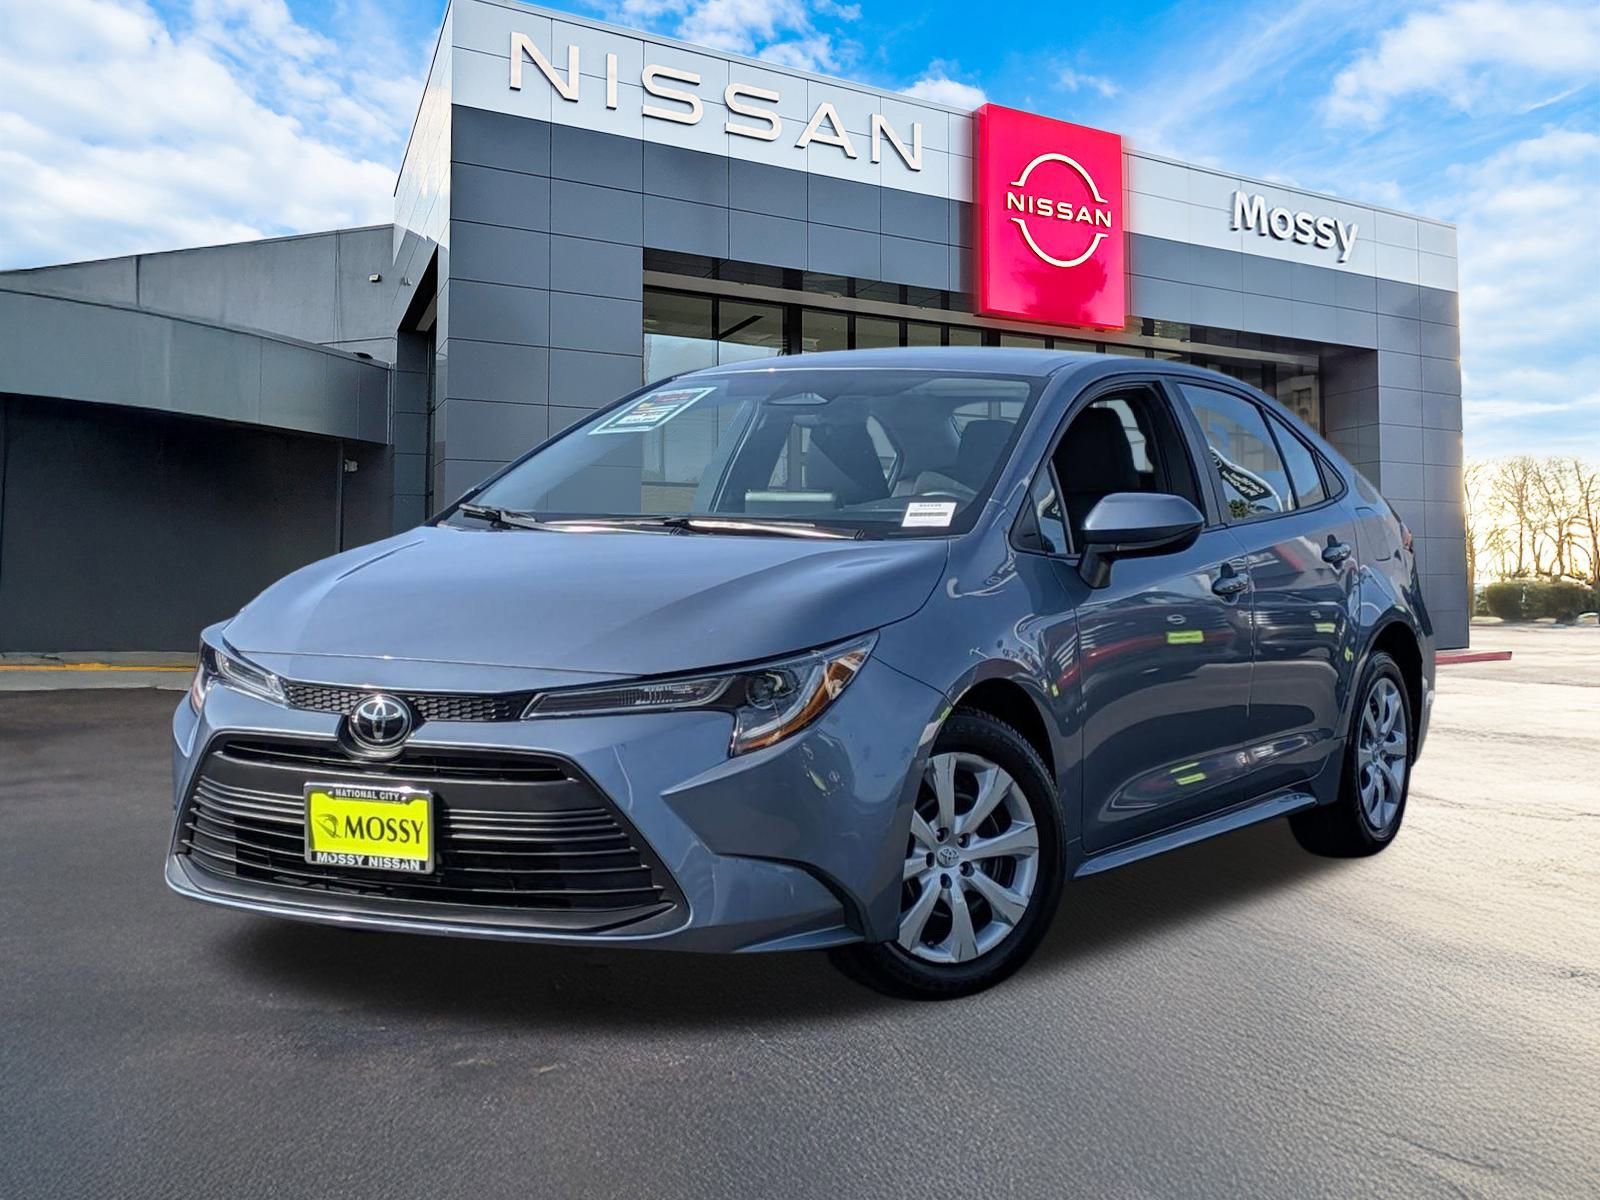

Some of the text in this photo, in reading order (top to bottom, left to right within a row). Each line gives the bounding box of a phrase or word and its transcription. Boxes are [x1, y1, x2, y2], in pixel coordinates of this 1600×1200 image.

[509, 31, 922, 171] NISSAN
[1007, 191, 1112, 228] NISSAN
[1230, 190, 1359, 263] Mossy
[335, 788, 401, 801] NATIONAL CITY
[344, 815, 424, 845] MOSSY
[316, 852, 420, 871] MOSSY NISSAN
